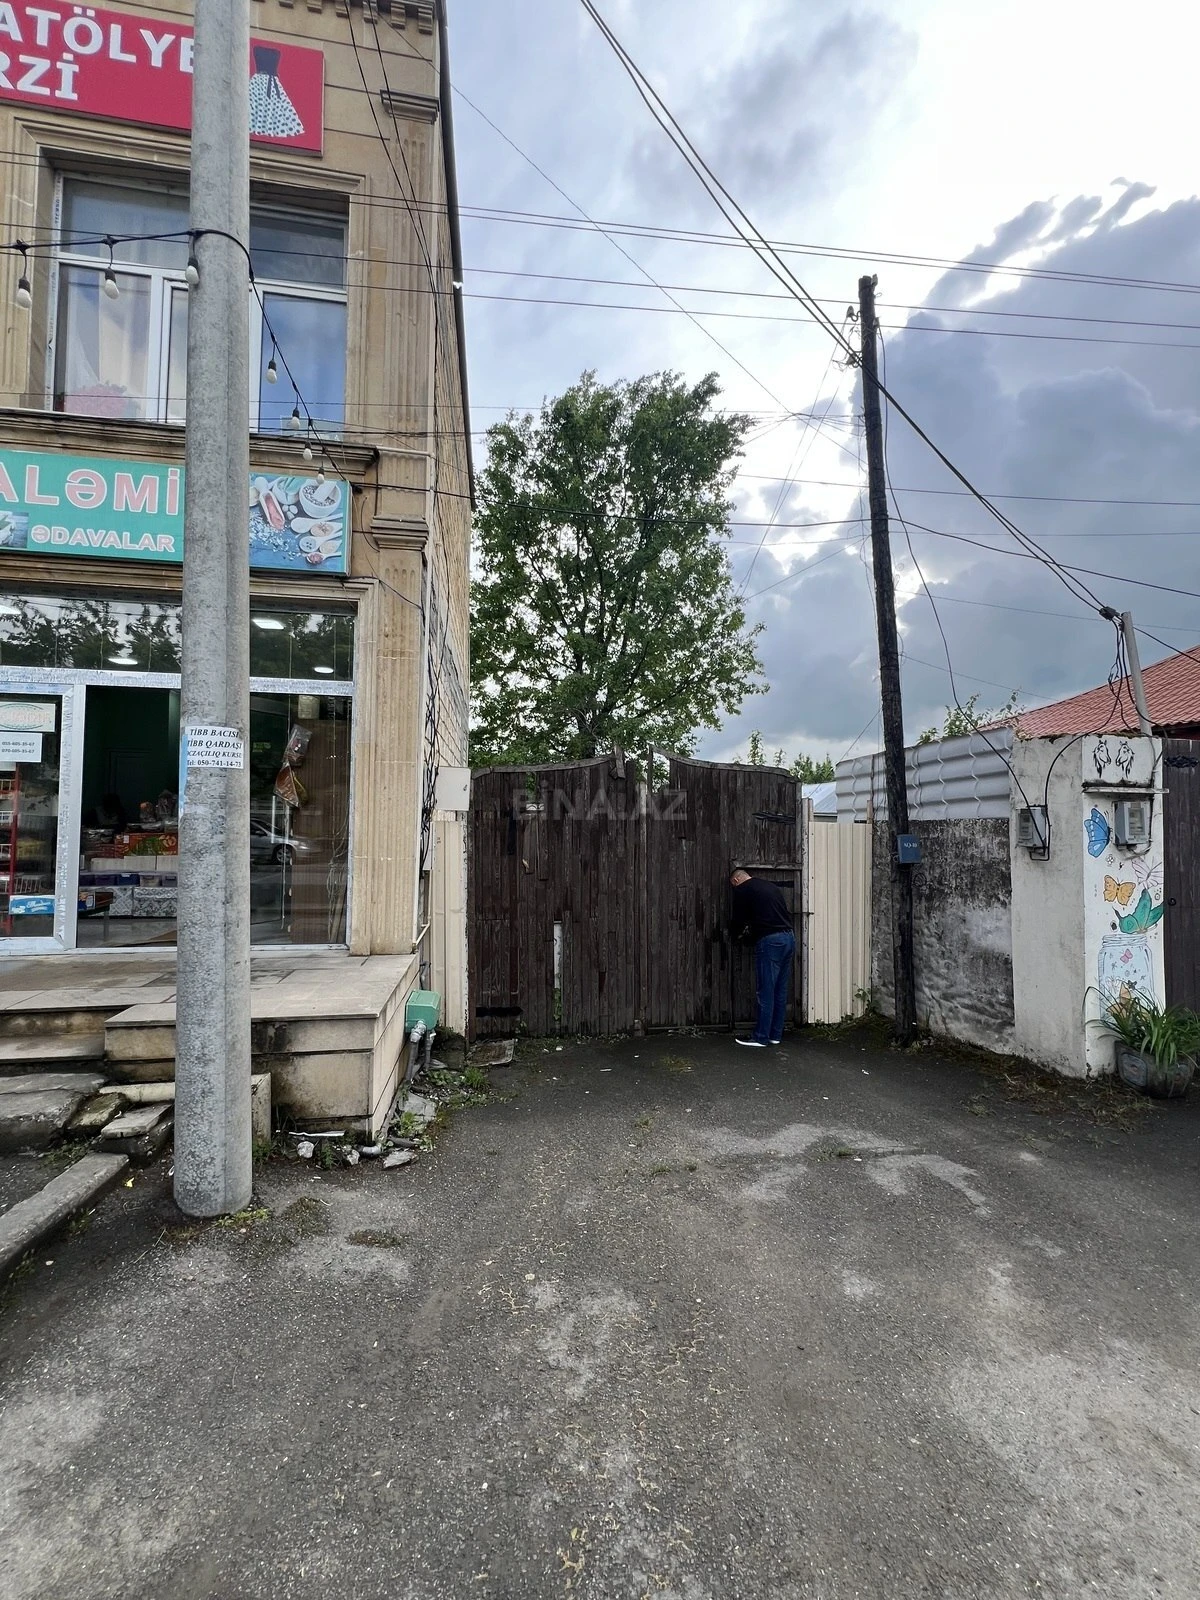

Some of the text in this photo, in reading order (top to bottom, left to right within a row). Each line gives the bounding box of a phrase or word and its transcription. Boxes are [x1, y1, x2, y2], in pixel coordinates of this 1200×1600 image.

[31, 525, 175, 552] ƏDAVALAR
[211, 730, 239, 738] BACISI
[206, 740, 242, 750] QARDAŞI
